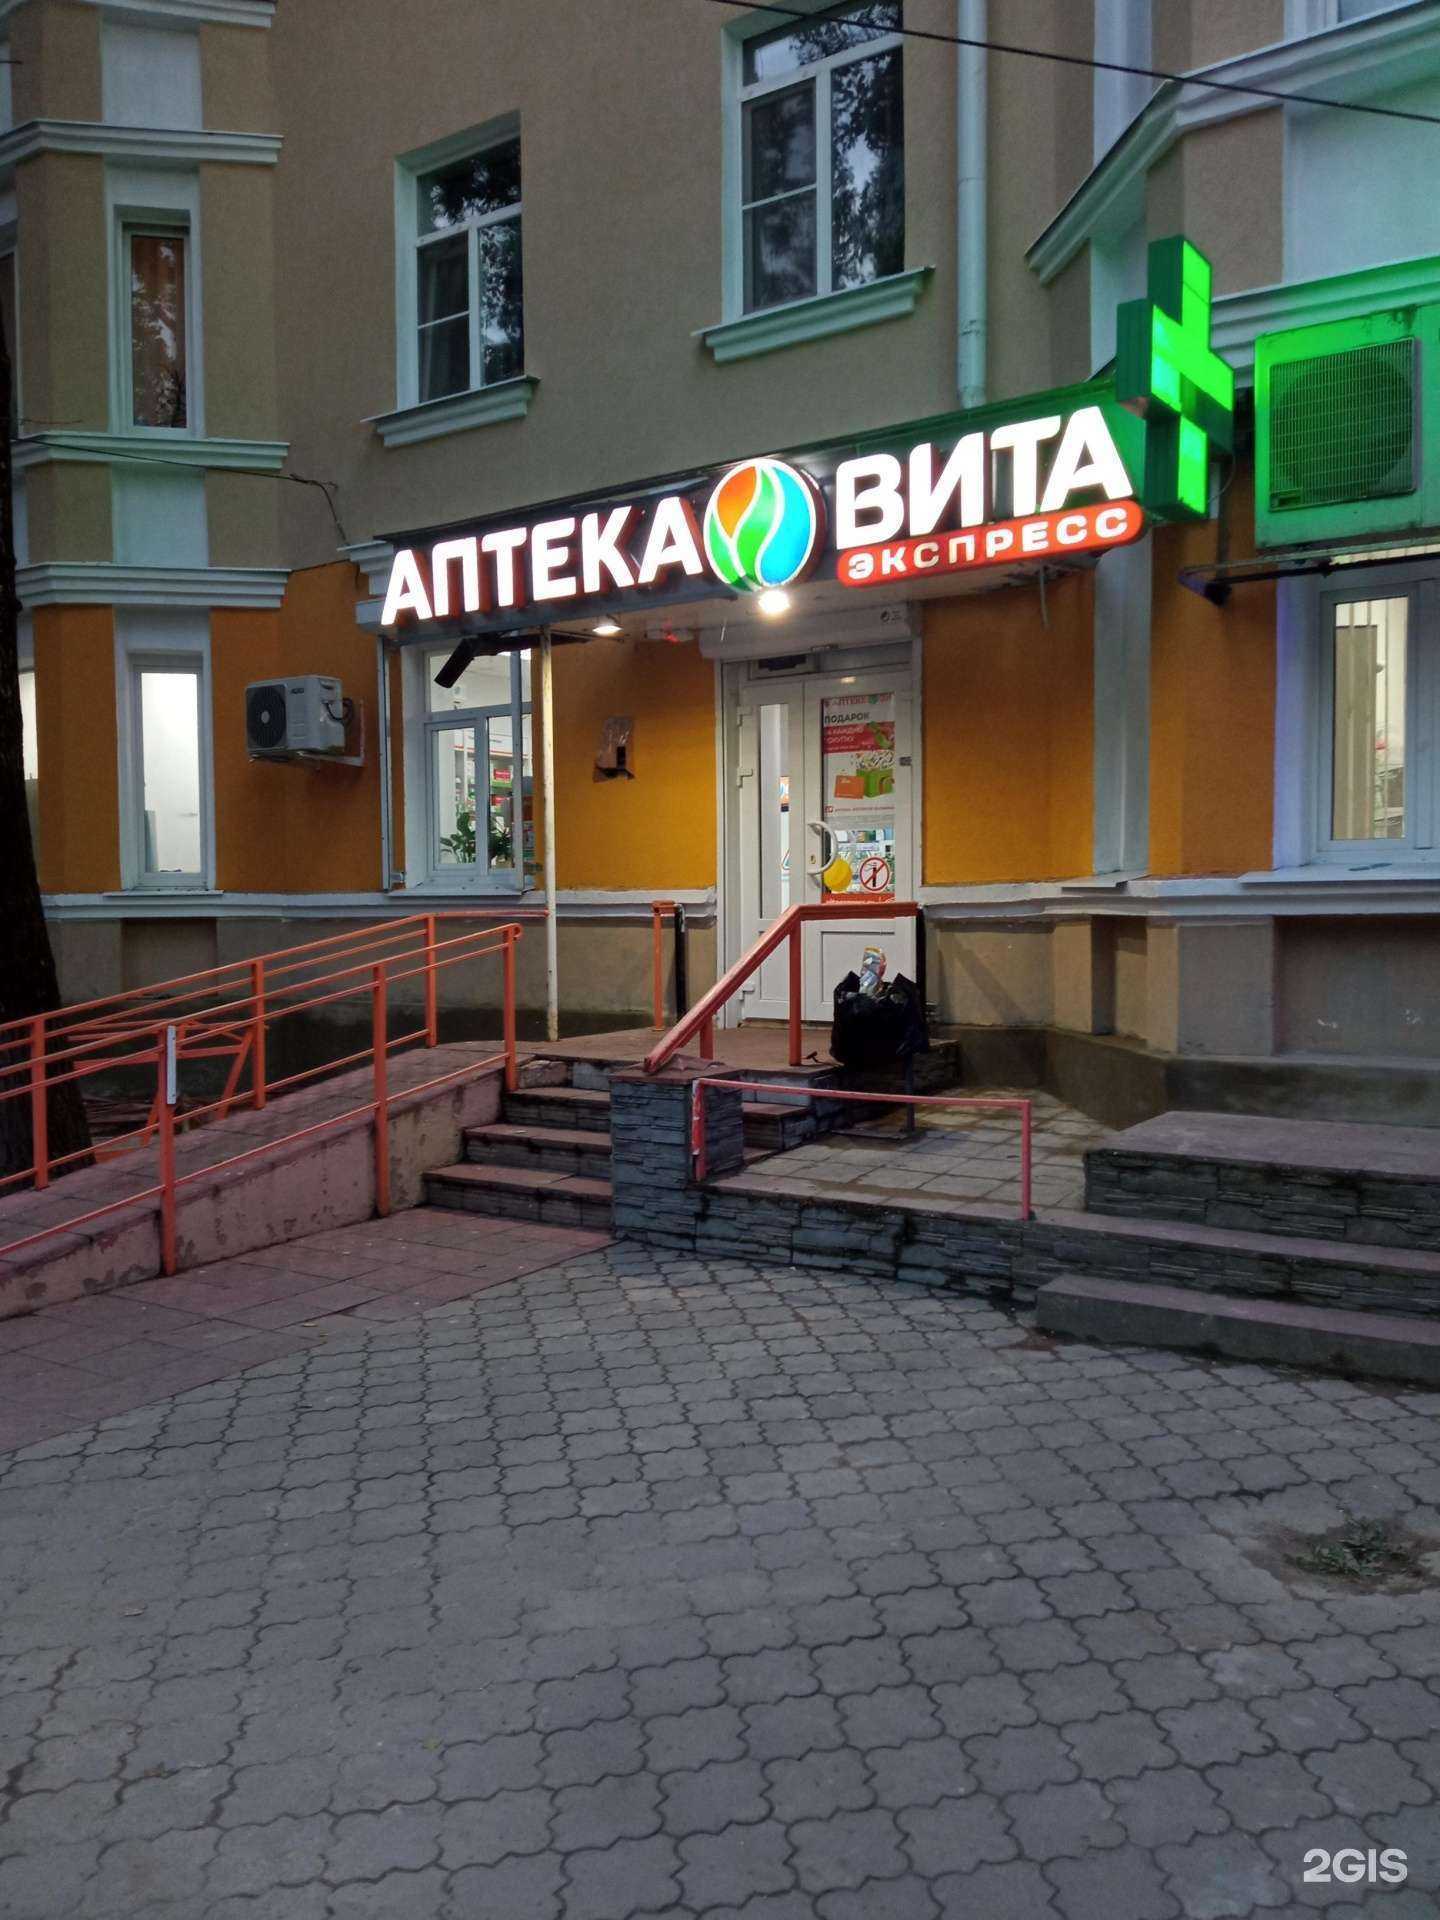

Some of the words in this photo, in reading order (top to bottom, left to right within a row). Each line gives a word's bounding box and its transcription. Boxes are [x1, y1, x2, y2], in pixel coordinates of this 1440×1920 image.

[381, 497, 703, 625] АПТЕКА
[836, 406, 1133, 550] ВИТА
[848, 507, 1128, 580] ЭКСПРЕСС
[825, 711, 870, 724] ПОДАРОК
